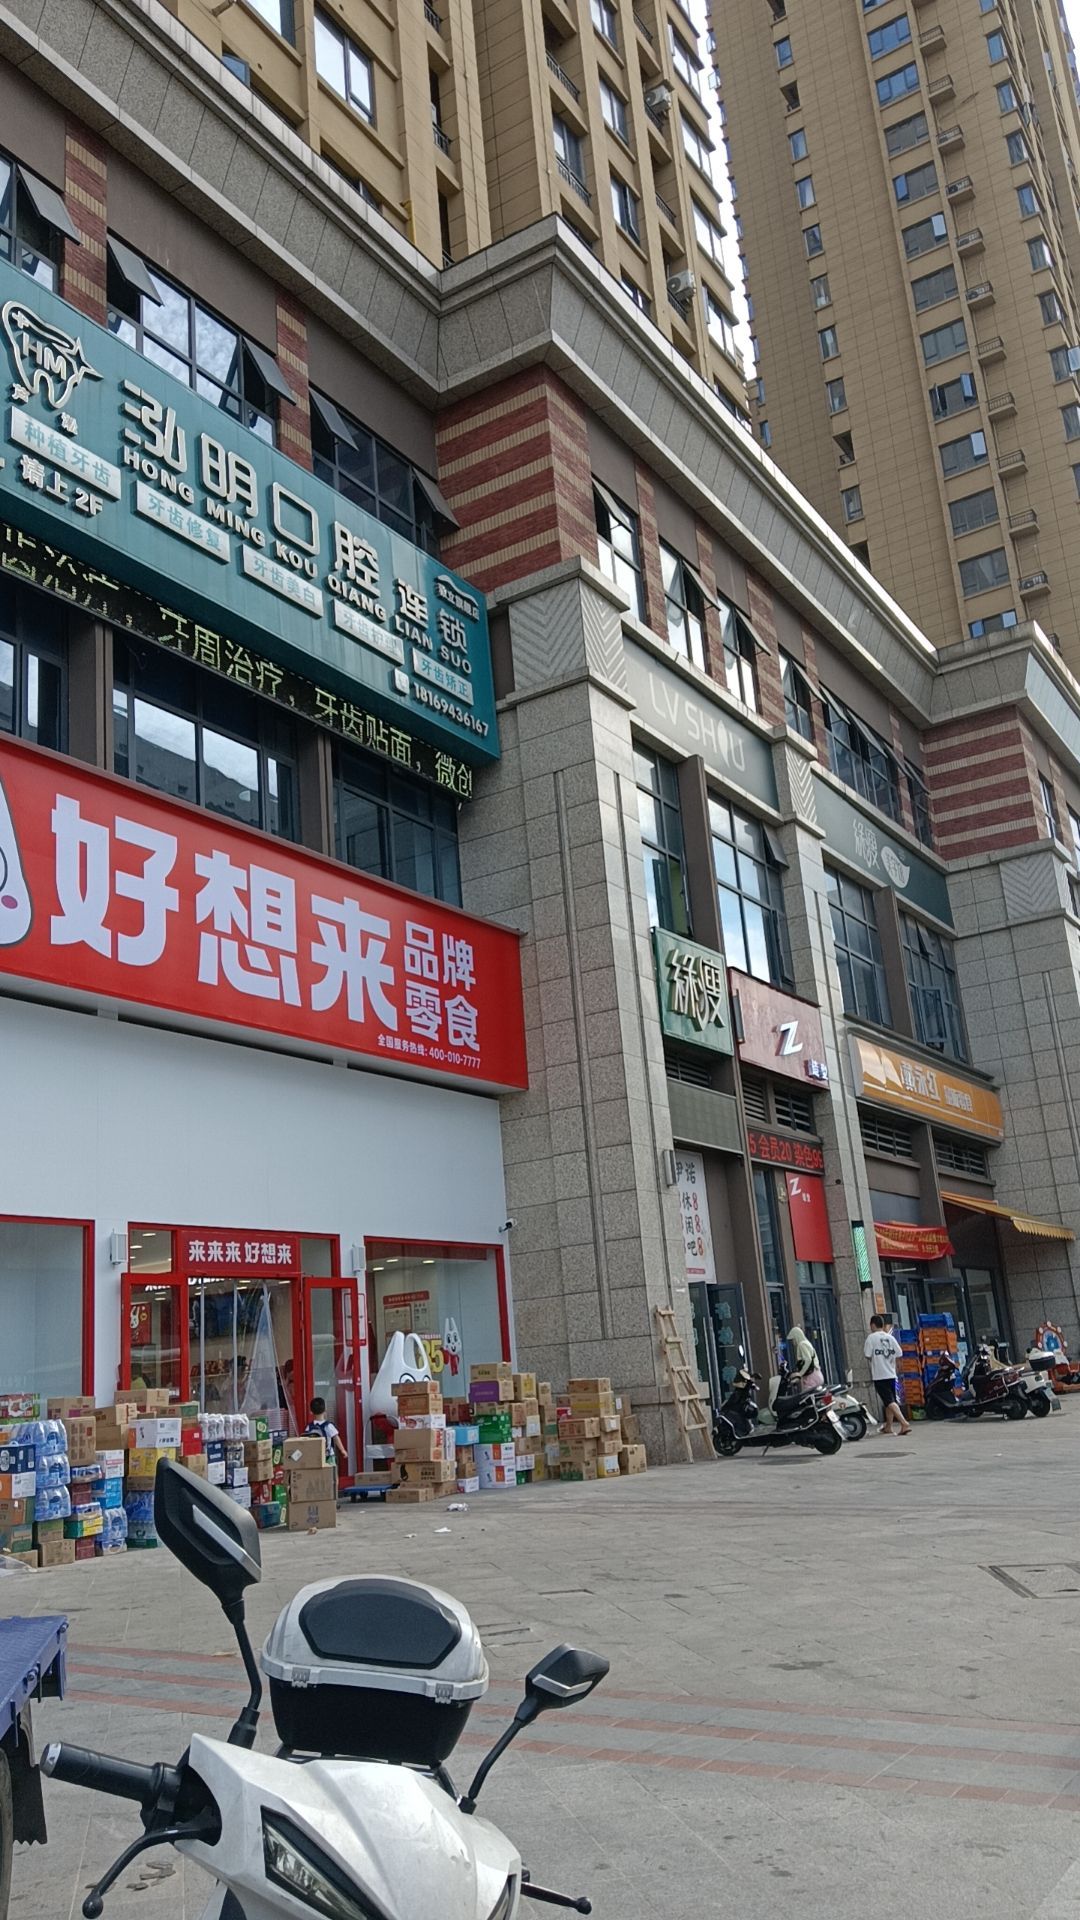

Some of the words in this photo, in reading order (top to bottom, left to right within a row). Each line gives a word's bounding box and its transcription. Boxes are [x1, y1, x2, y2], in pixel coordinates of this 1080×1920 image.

[23, 331, 67, 382] HM
[24, 420, 112, 488] 种植牙齿
[123, 379, 468, 655] 泓明口腔连锁
[147, 492, 222, 552] 牙齿修复
[123, 444, 195, 504] HONG
[206, 497, 266, 548] MING
[275, 540, 318, 578] KOU
[327, 573, 387, 622] QIANG
[395, 614, 433, 651] LIAN
[440, 645, 473, 674] SUO
[253, 556, 316, 607] 牙齿美白
[413, 681, 489, 738] 18169436167
[648, 672, 680, 726] LV
[50, 793, 398, 1032] 好想来
[403, 919, 476, 992] 品牌
[405, 980, 481, 1052] 零食
[779, 1020, 804, 1056] Z
